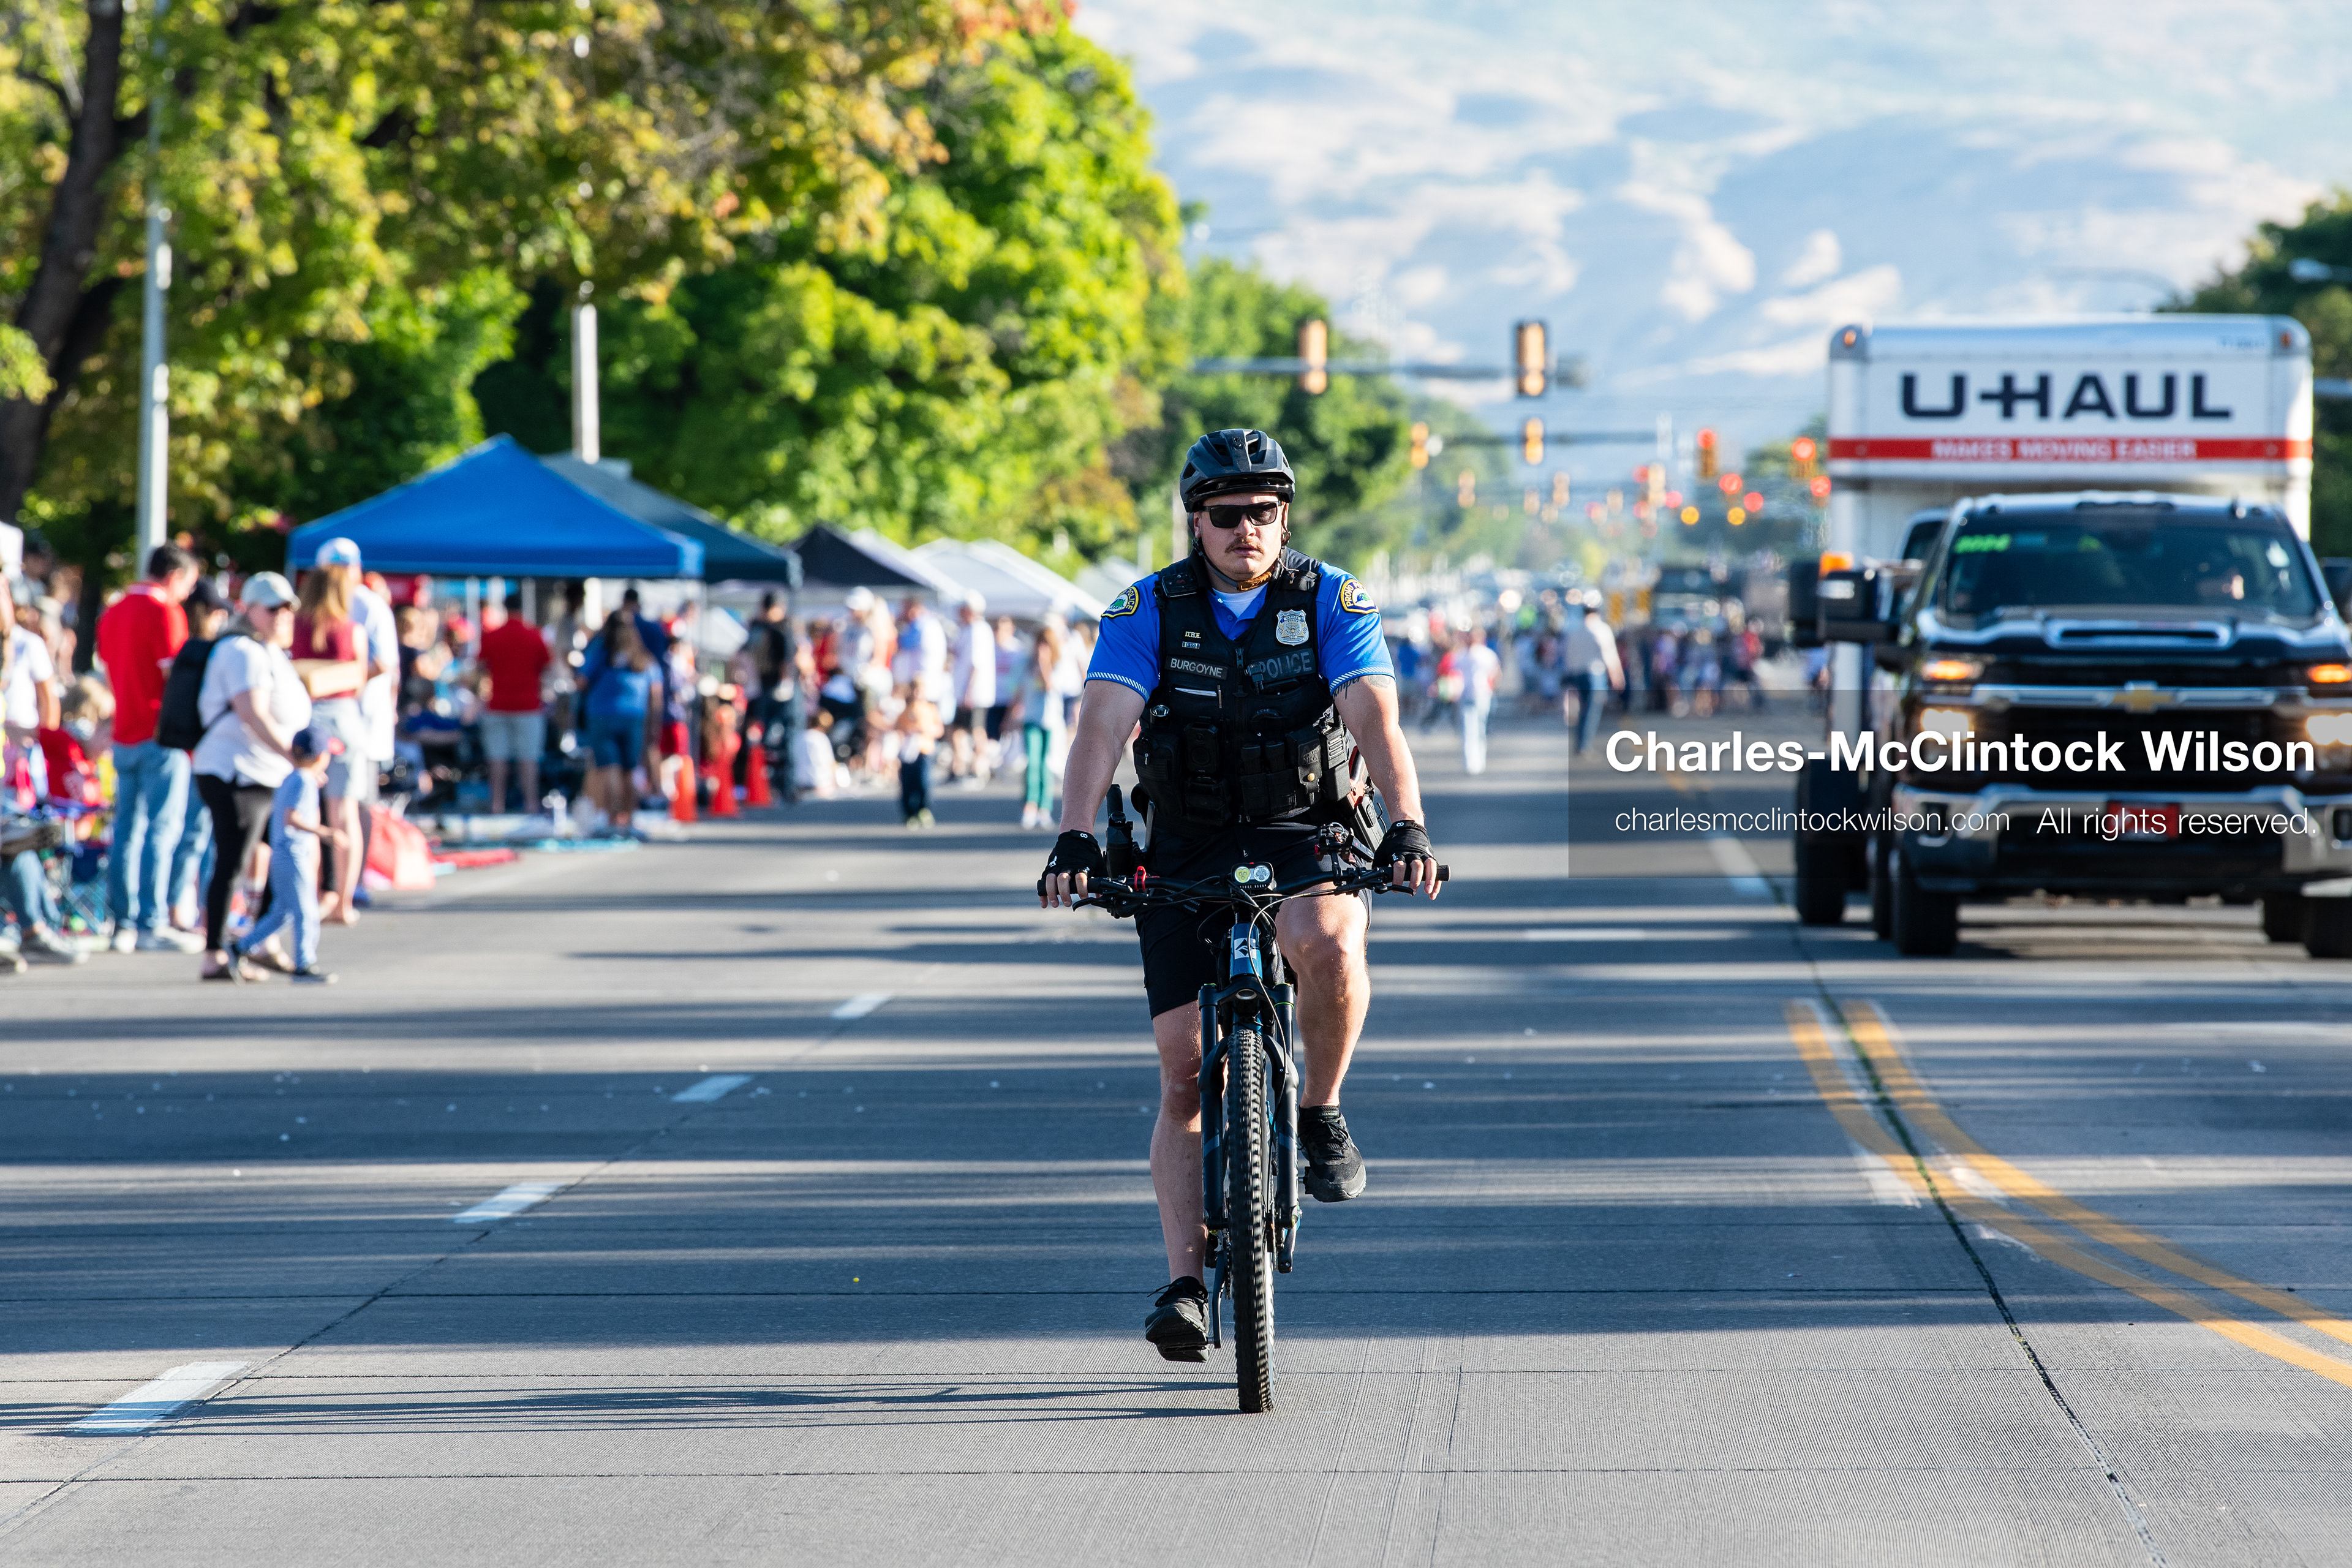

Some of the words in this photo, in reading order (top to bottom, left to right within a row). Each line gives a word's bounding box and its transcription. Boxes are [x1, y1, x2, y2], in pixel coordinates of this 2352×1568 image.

[1901, 374, 2232, 420] U-HAUL
[1933, 440, 2010, 459] MAKES
[2019, 440, 2110, 459] MOVING
[2118, 440, 2196, 459] EASIER
[1344, 584, 1354, 606] PROVO
[1170, 658, 1223, 677] BURGOYNE
